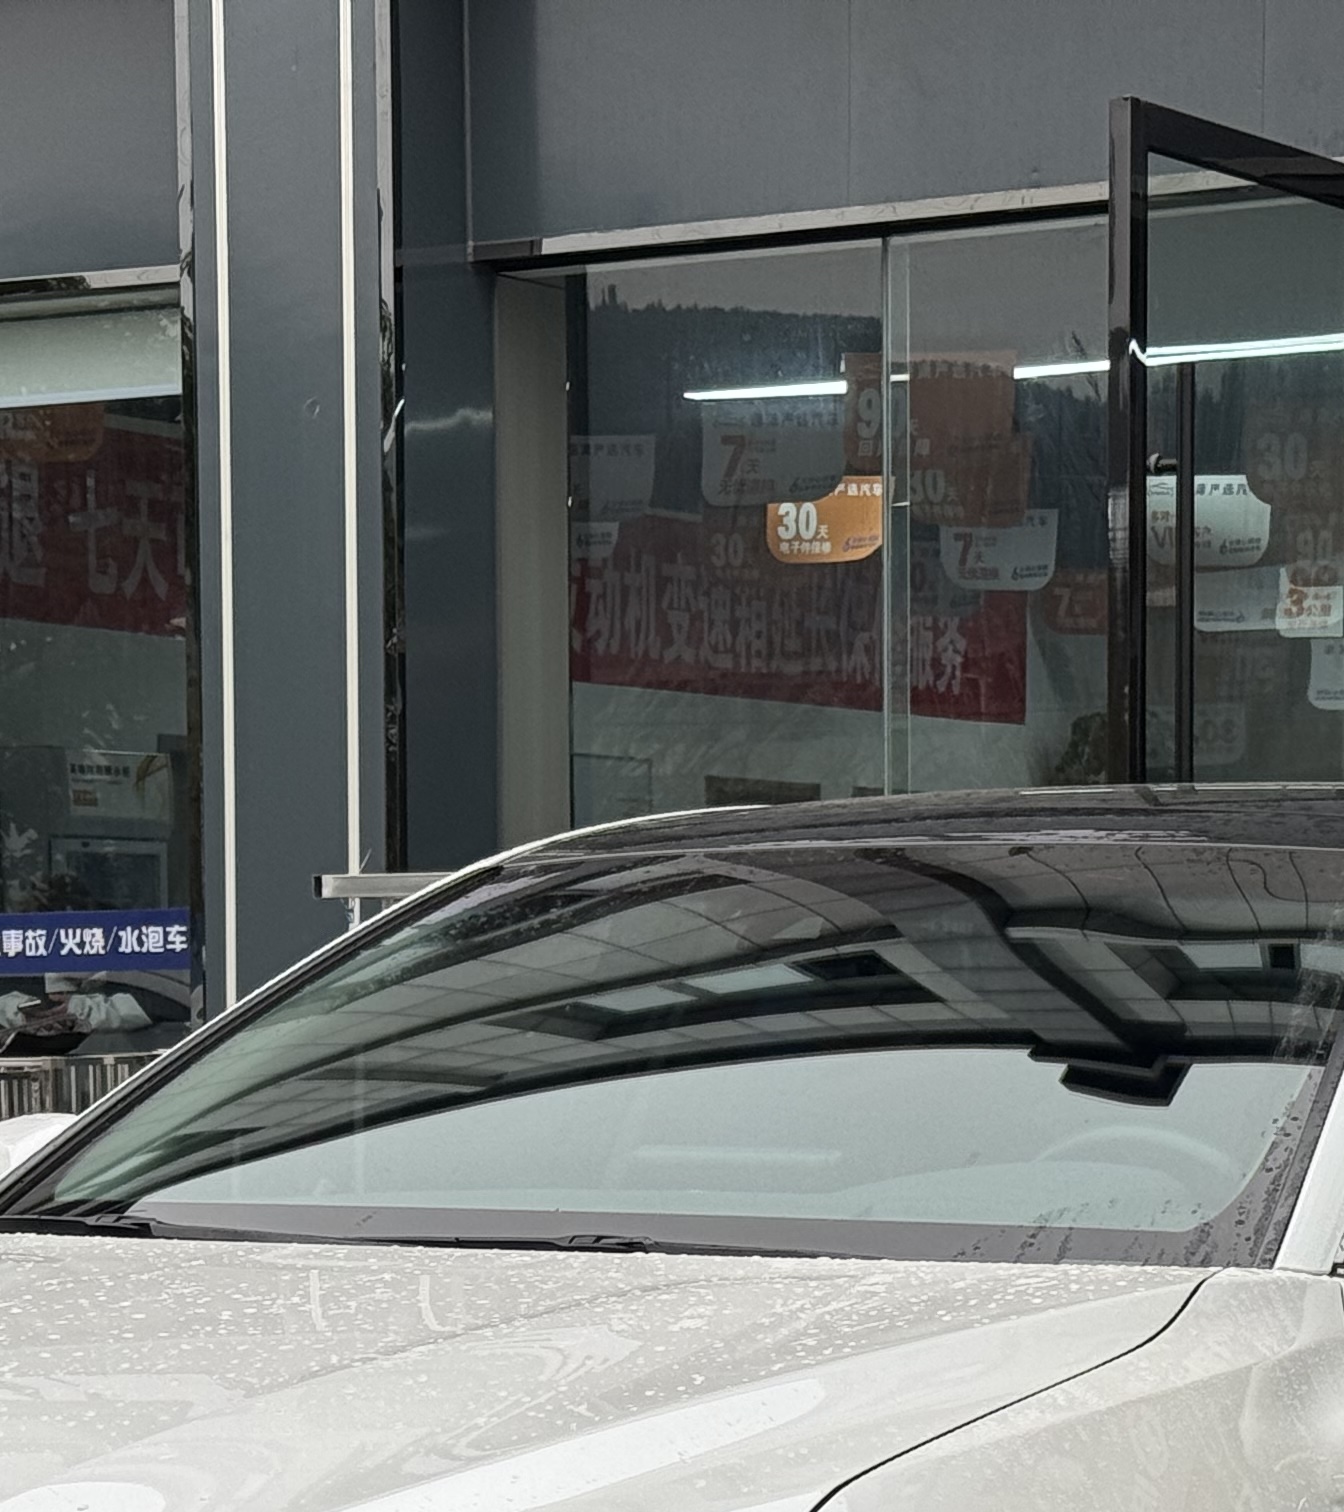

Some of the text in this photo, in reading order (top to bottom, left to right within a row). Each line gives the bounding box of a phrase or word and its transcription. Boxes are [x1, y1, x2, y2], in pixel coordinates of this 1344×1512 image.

[720, 435, 746, 480] 7
[776, 501, 830, 541] 30 天
